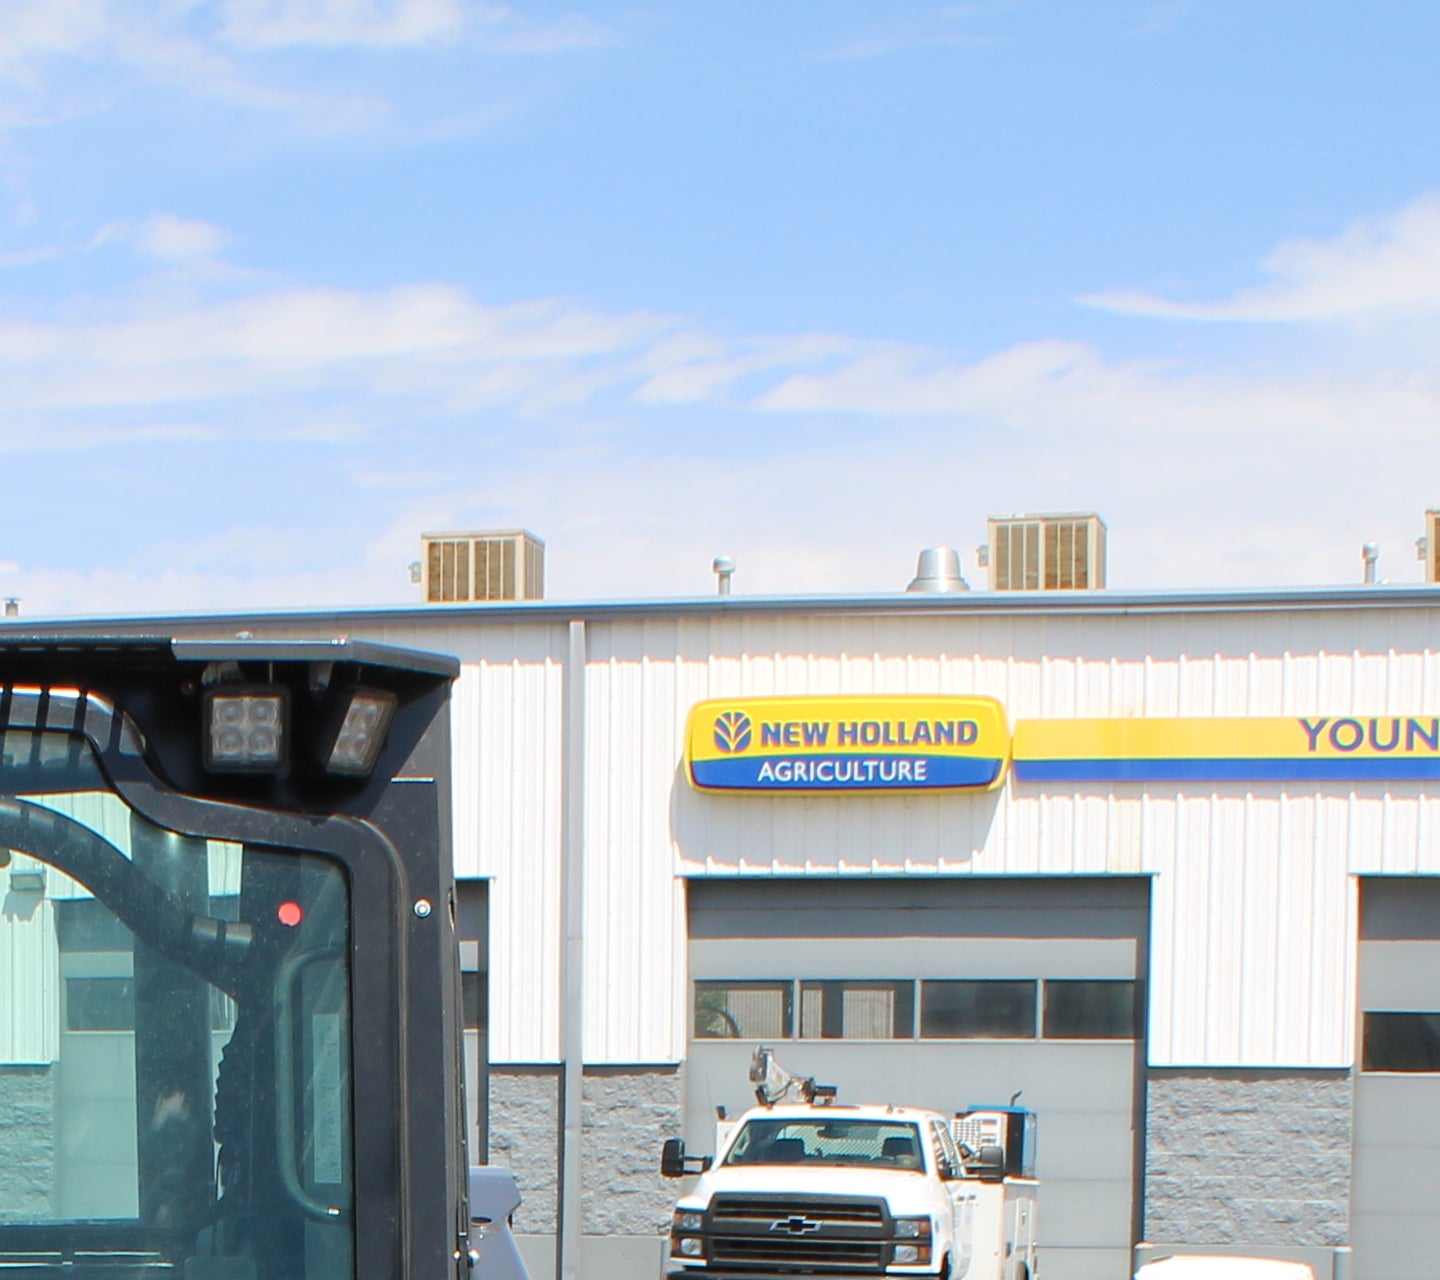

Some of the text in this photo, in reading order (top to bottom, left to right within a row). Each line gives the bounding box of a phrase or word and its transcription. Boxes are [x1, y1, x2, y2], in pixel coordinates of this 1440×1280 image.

[760, 720, 979, 748] NEW HOLLAND
[756, 759, 928, 784] AGRICULTURE
